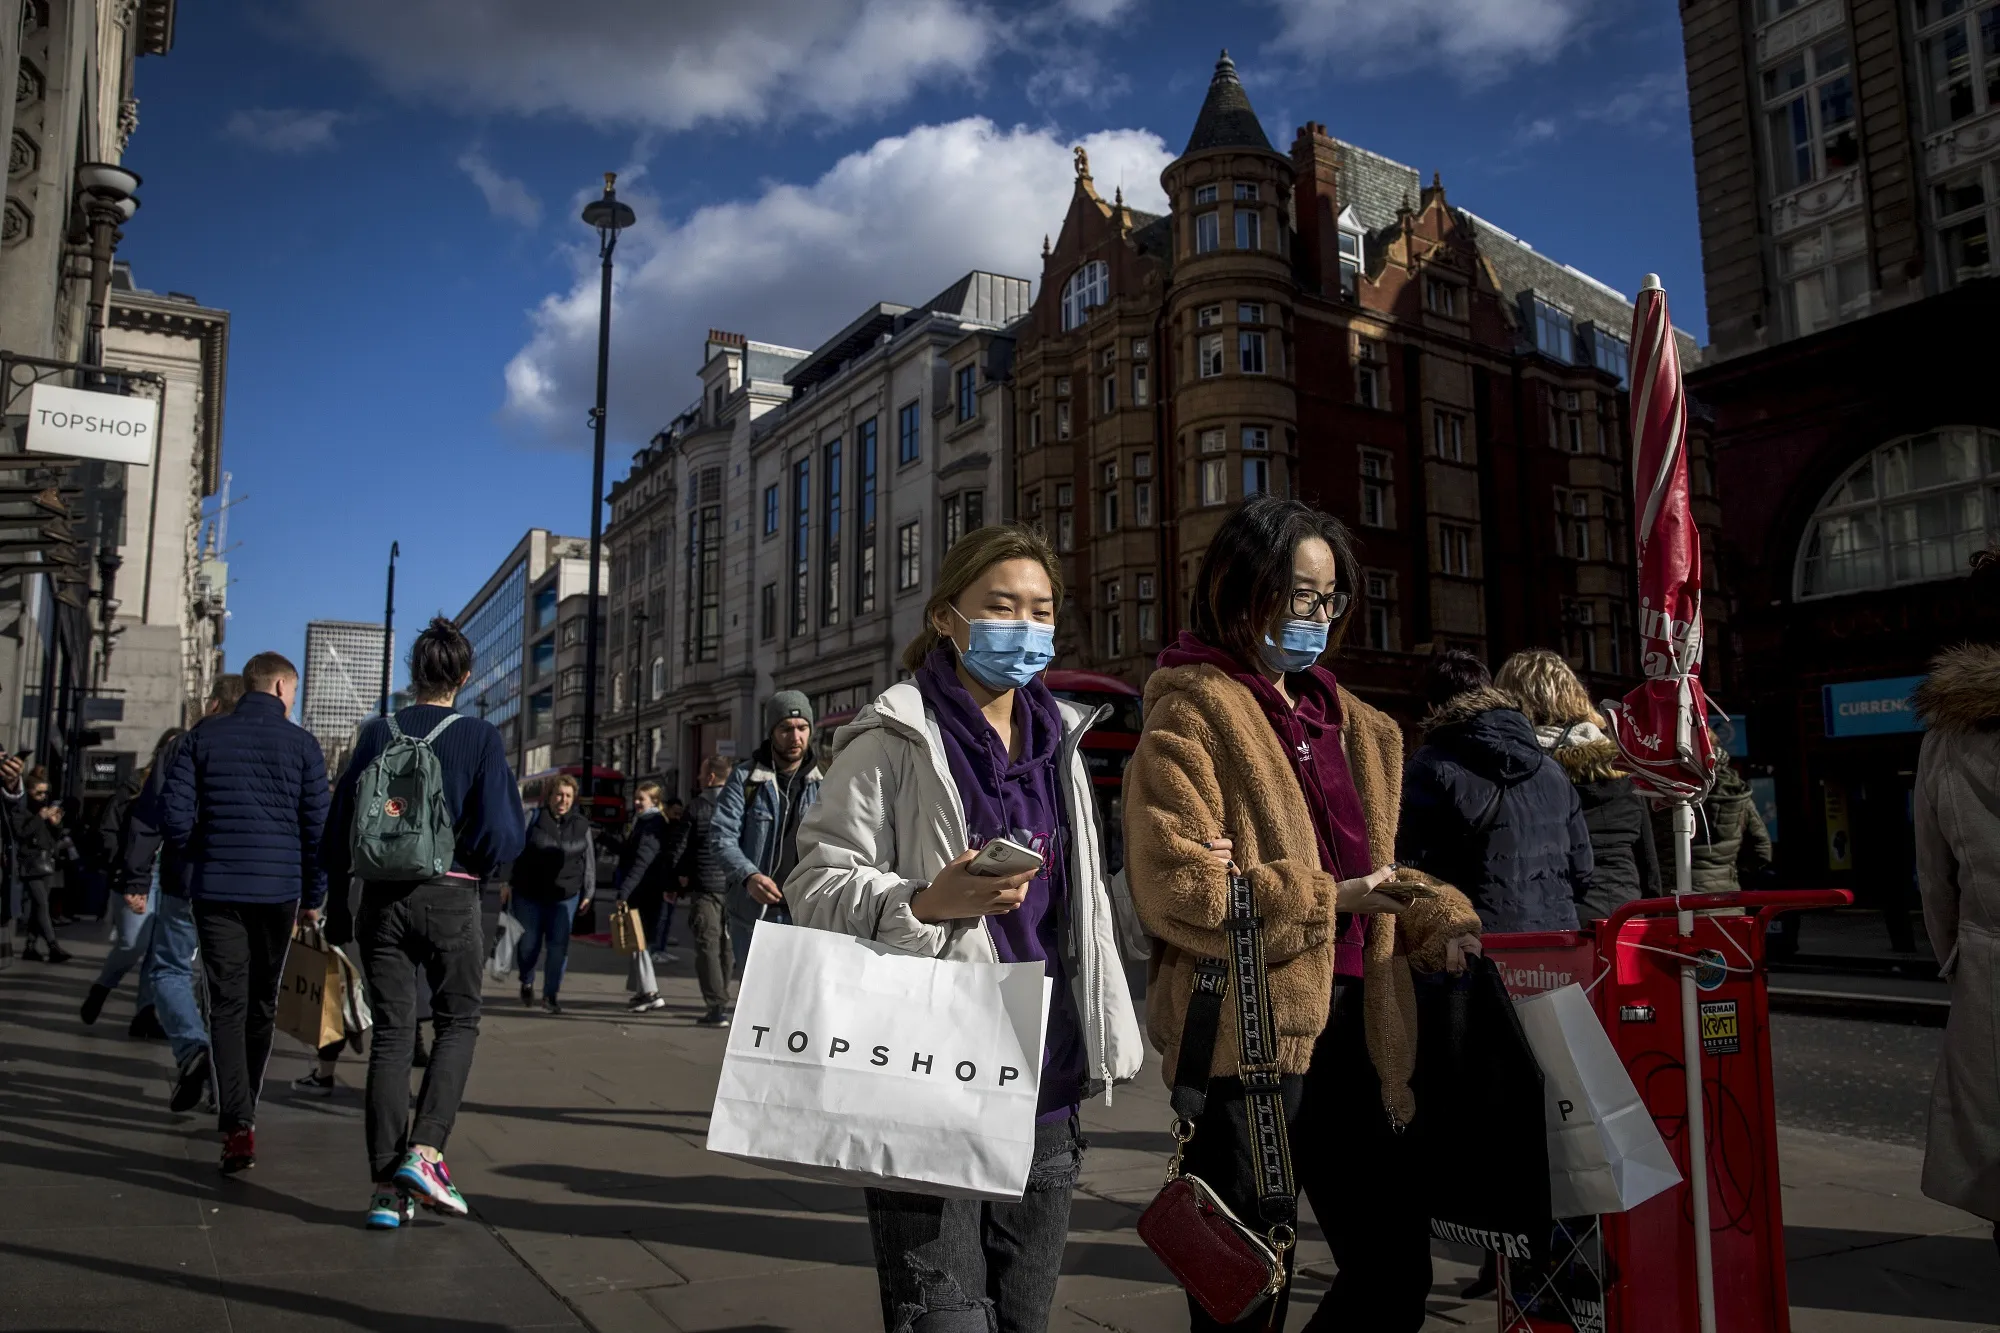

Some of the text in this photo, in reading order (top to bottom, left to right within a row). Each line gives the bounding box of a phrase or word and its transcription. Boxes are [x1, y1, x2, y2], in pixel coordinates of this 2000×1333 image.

[37, 409, 148, 438] TOPSHOP
[1703, 1004, 1734, 1013] GERMAN
[1704, 1017, 1734, 1036] KRAFT
[1703, 1038, 1738, 1046] BREWERY
[751, 1025, 1020, 1087] TOPSHOP
[1558, 1100, 1574, 1121] P
[1431, 1217, 1532, 1260] OUTFITTERS
[1572, 1297, 1602, 1317] WIN
